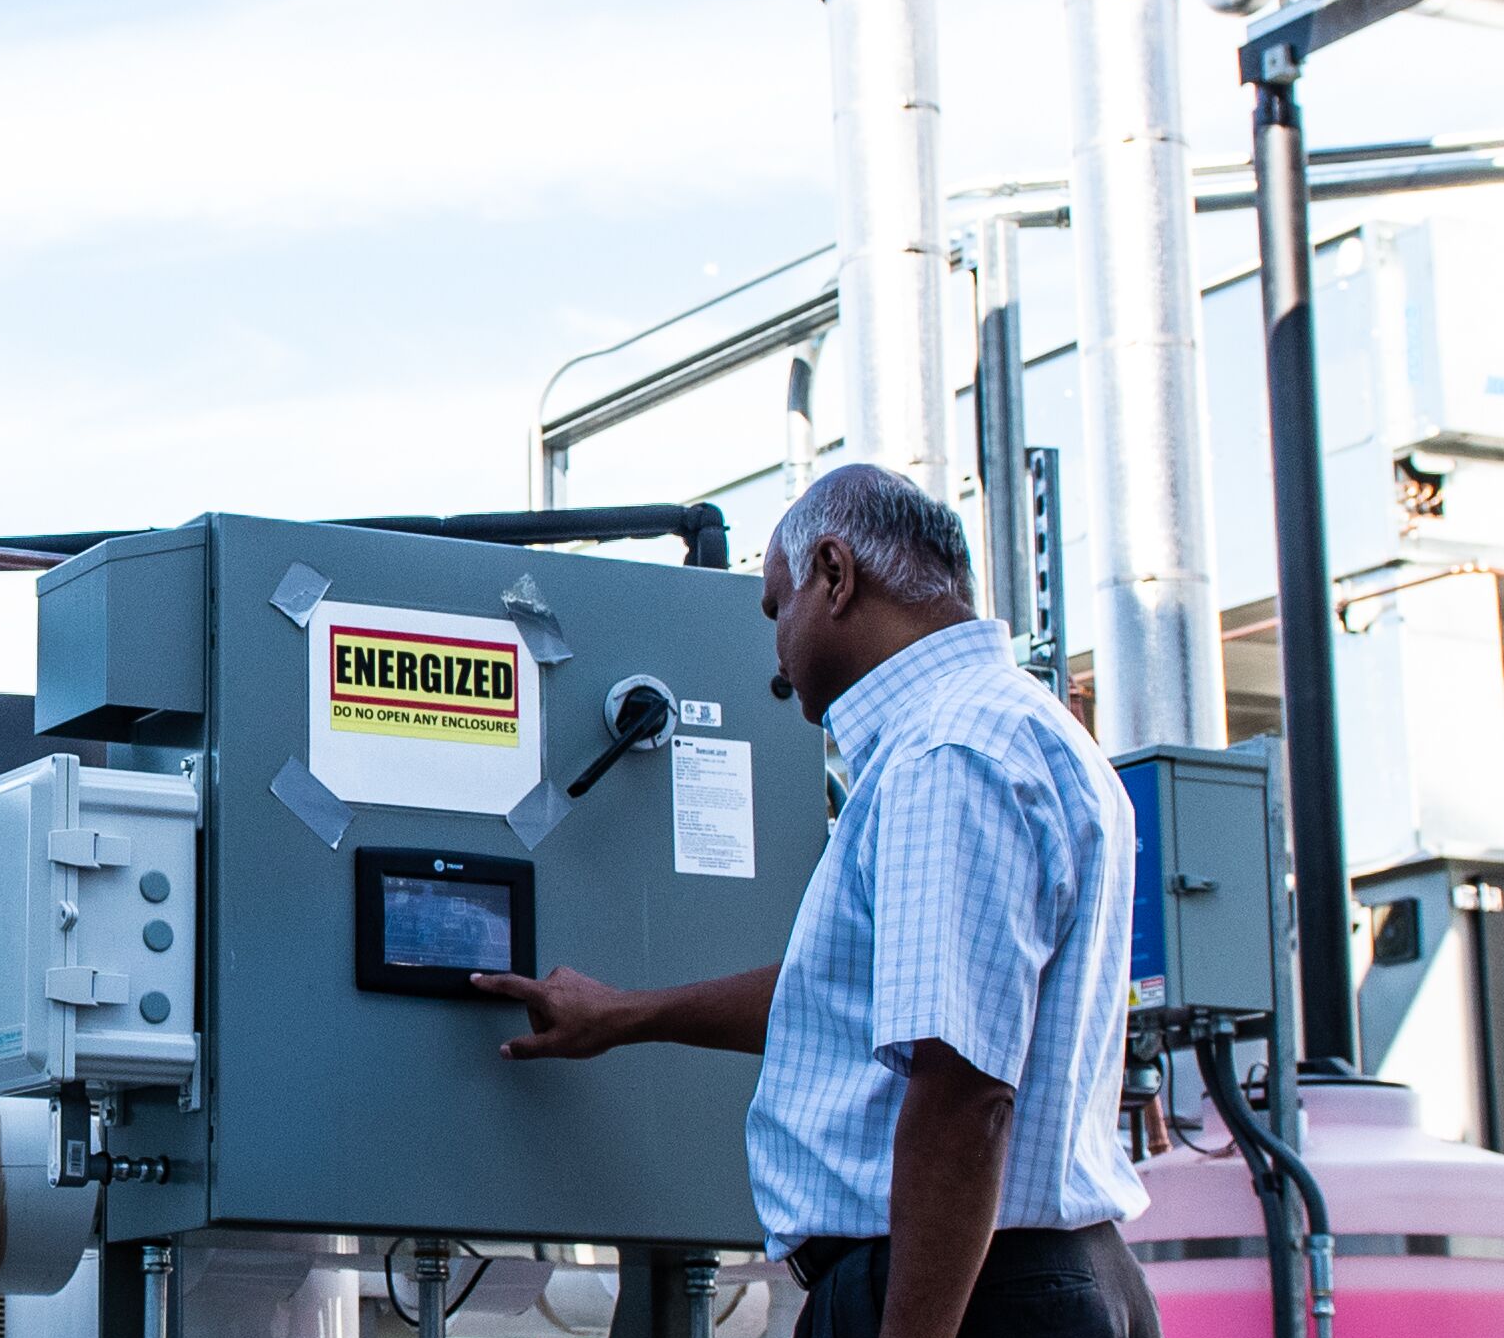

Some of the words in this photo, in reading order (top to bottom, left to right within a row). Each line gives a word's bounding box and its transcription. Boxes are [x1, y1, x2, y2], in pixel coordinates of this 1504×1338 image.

[336, 645, 513, 700] ENERGIZED
[333, 705, 351, 718] DO
[355, 707, 374, 720] NO
[377, 709, 410, 723] OPEN
[413, 712, 438, 726] ANY
[442, 715, 517, 734] ENCLOSURES
